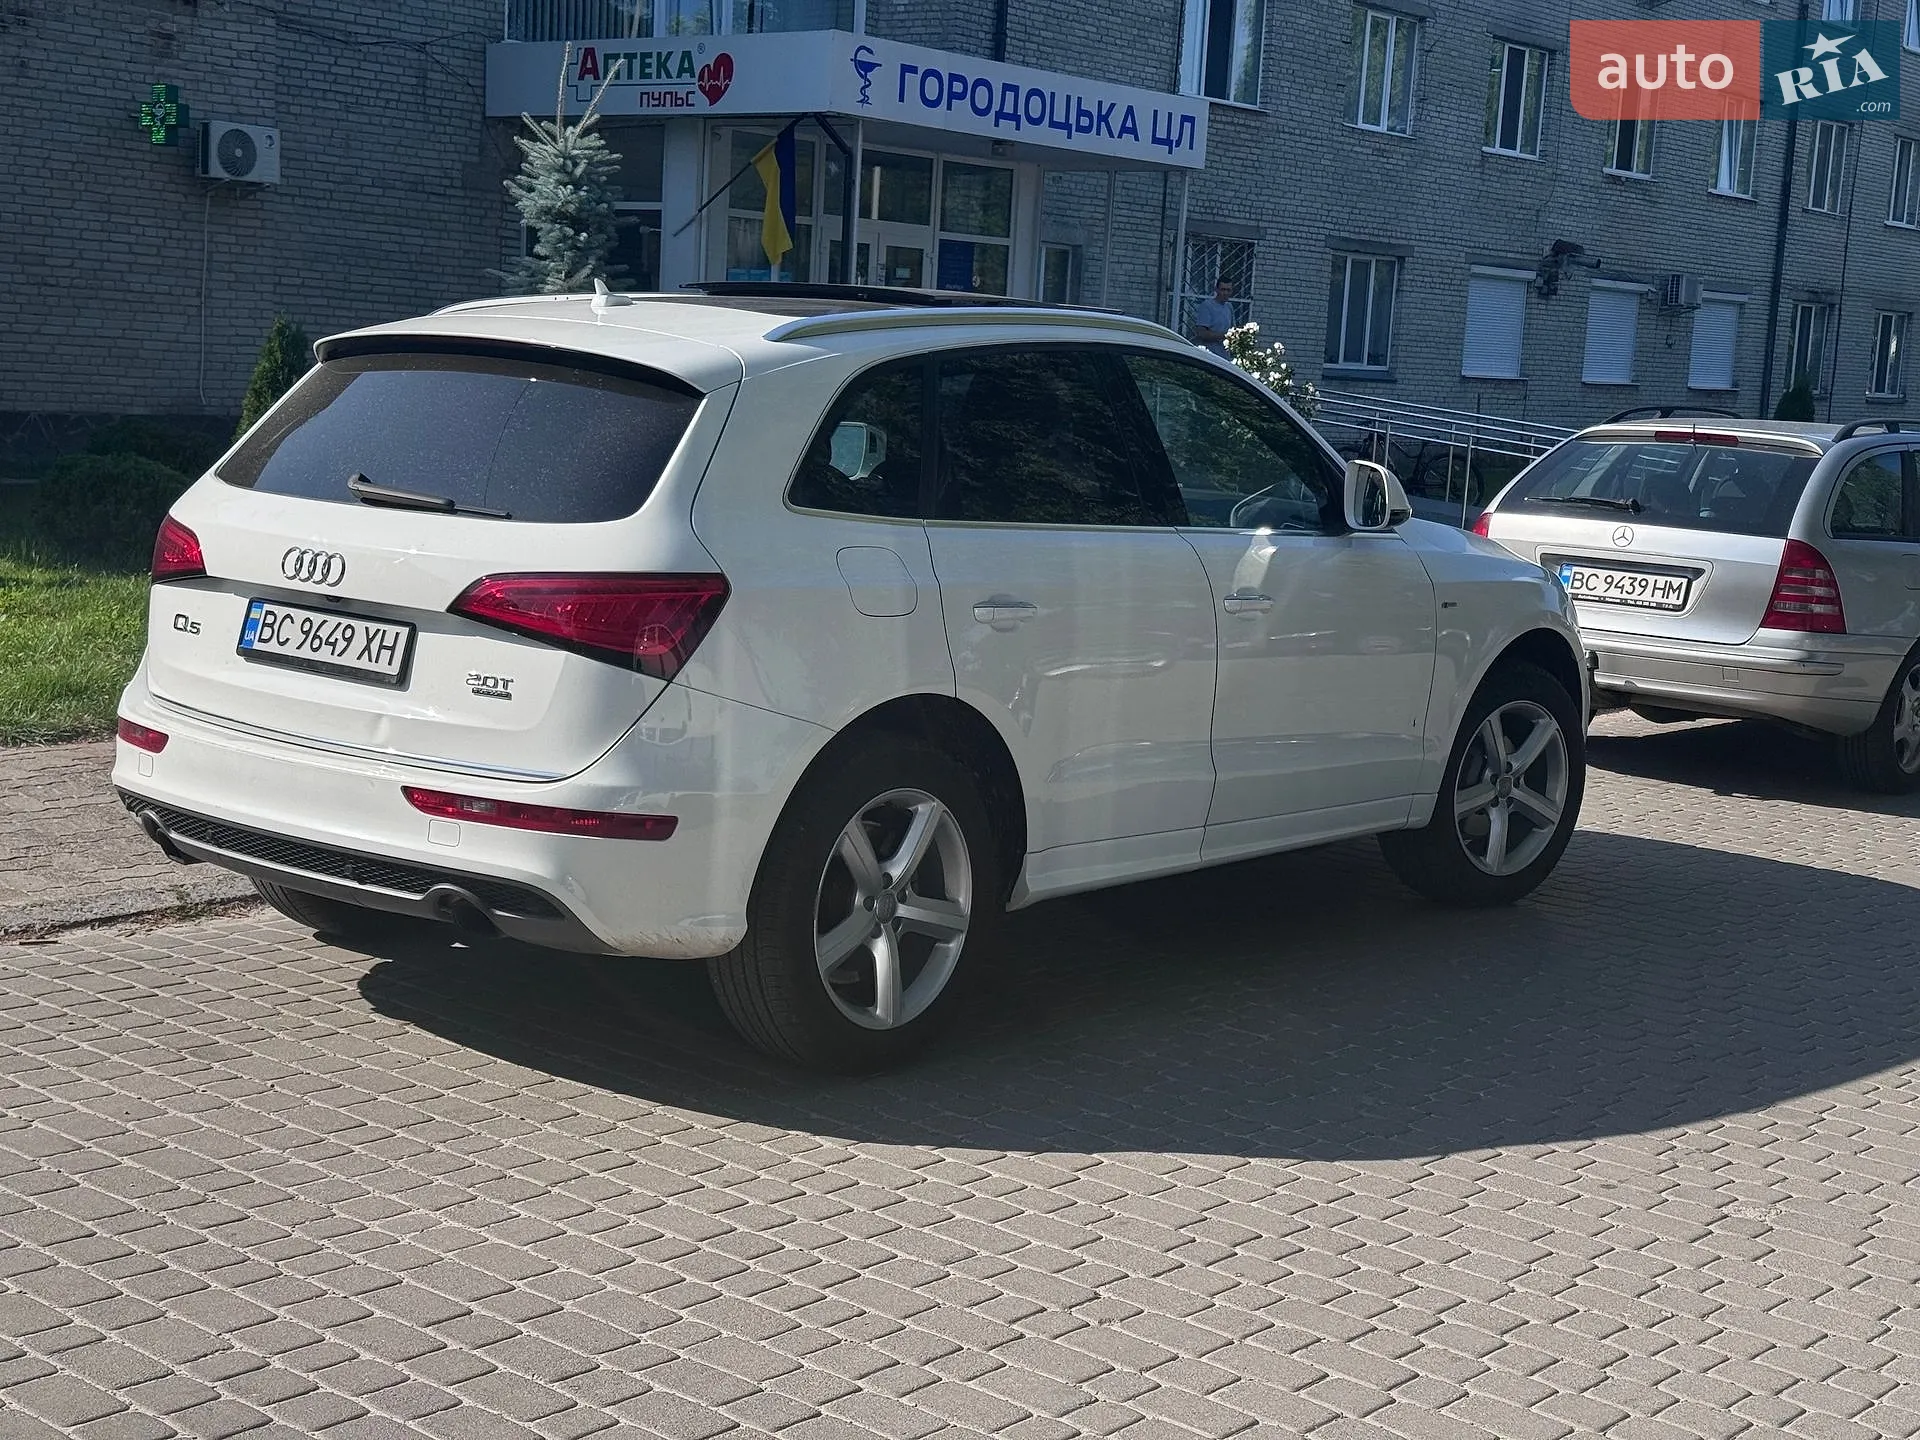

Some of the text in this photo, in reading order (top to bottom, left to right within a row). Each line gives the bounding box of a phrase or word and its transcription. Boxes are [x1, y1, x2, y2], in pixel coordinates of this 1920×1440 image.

[577, 47, 696, 81] АПТЕКА
[639, 90, 696, 108] ПУЛЬС
[897, 63, 1196, 155] ГОРОДОЦЬКА ЦЛ
[1570, 571, 1684, 601] BC 9439 HM
[173, 613, 202, 635] Q5
[244, 630, 256, 641] UA
[257, 609, 400, 667] BC 9649 XH
